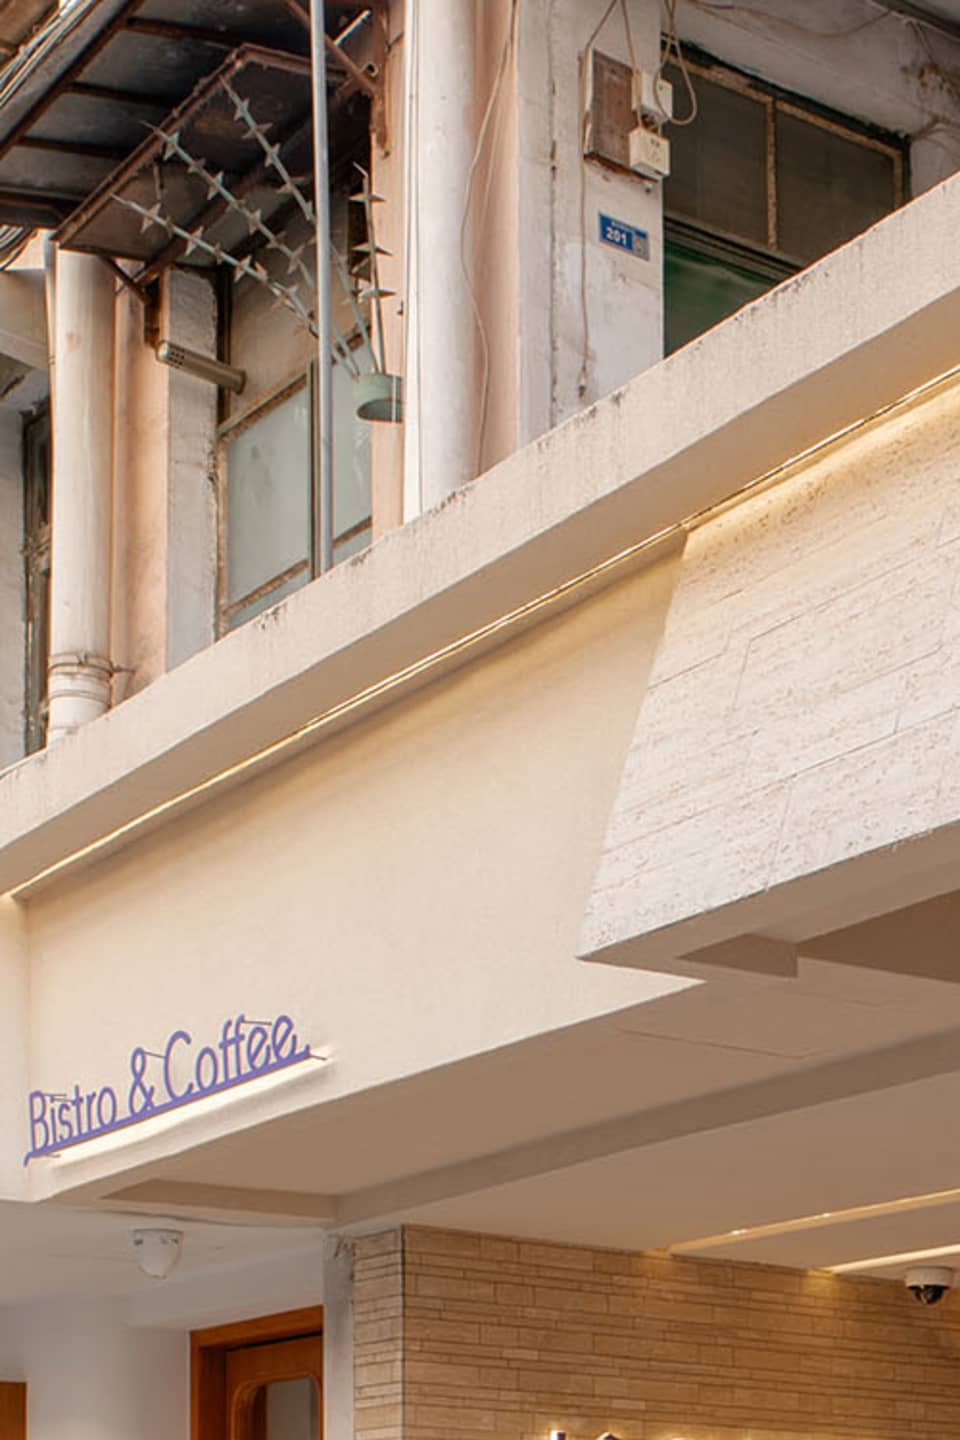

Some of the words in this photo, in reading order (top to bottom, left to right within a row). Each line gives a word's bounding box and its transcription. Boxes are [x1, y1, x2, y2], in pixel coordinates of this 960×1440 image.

[606, 226, 627, 246] 201
[29, 1085, 117, 1152] Bistro
[128, 1047, 156, 1117] &
[163, 1013, 299, 1101] Coffee
